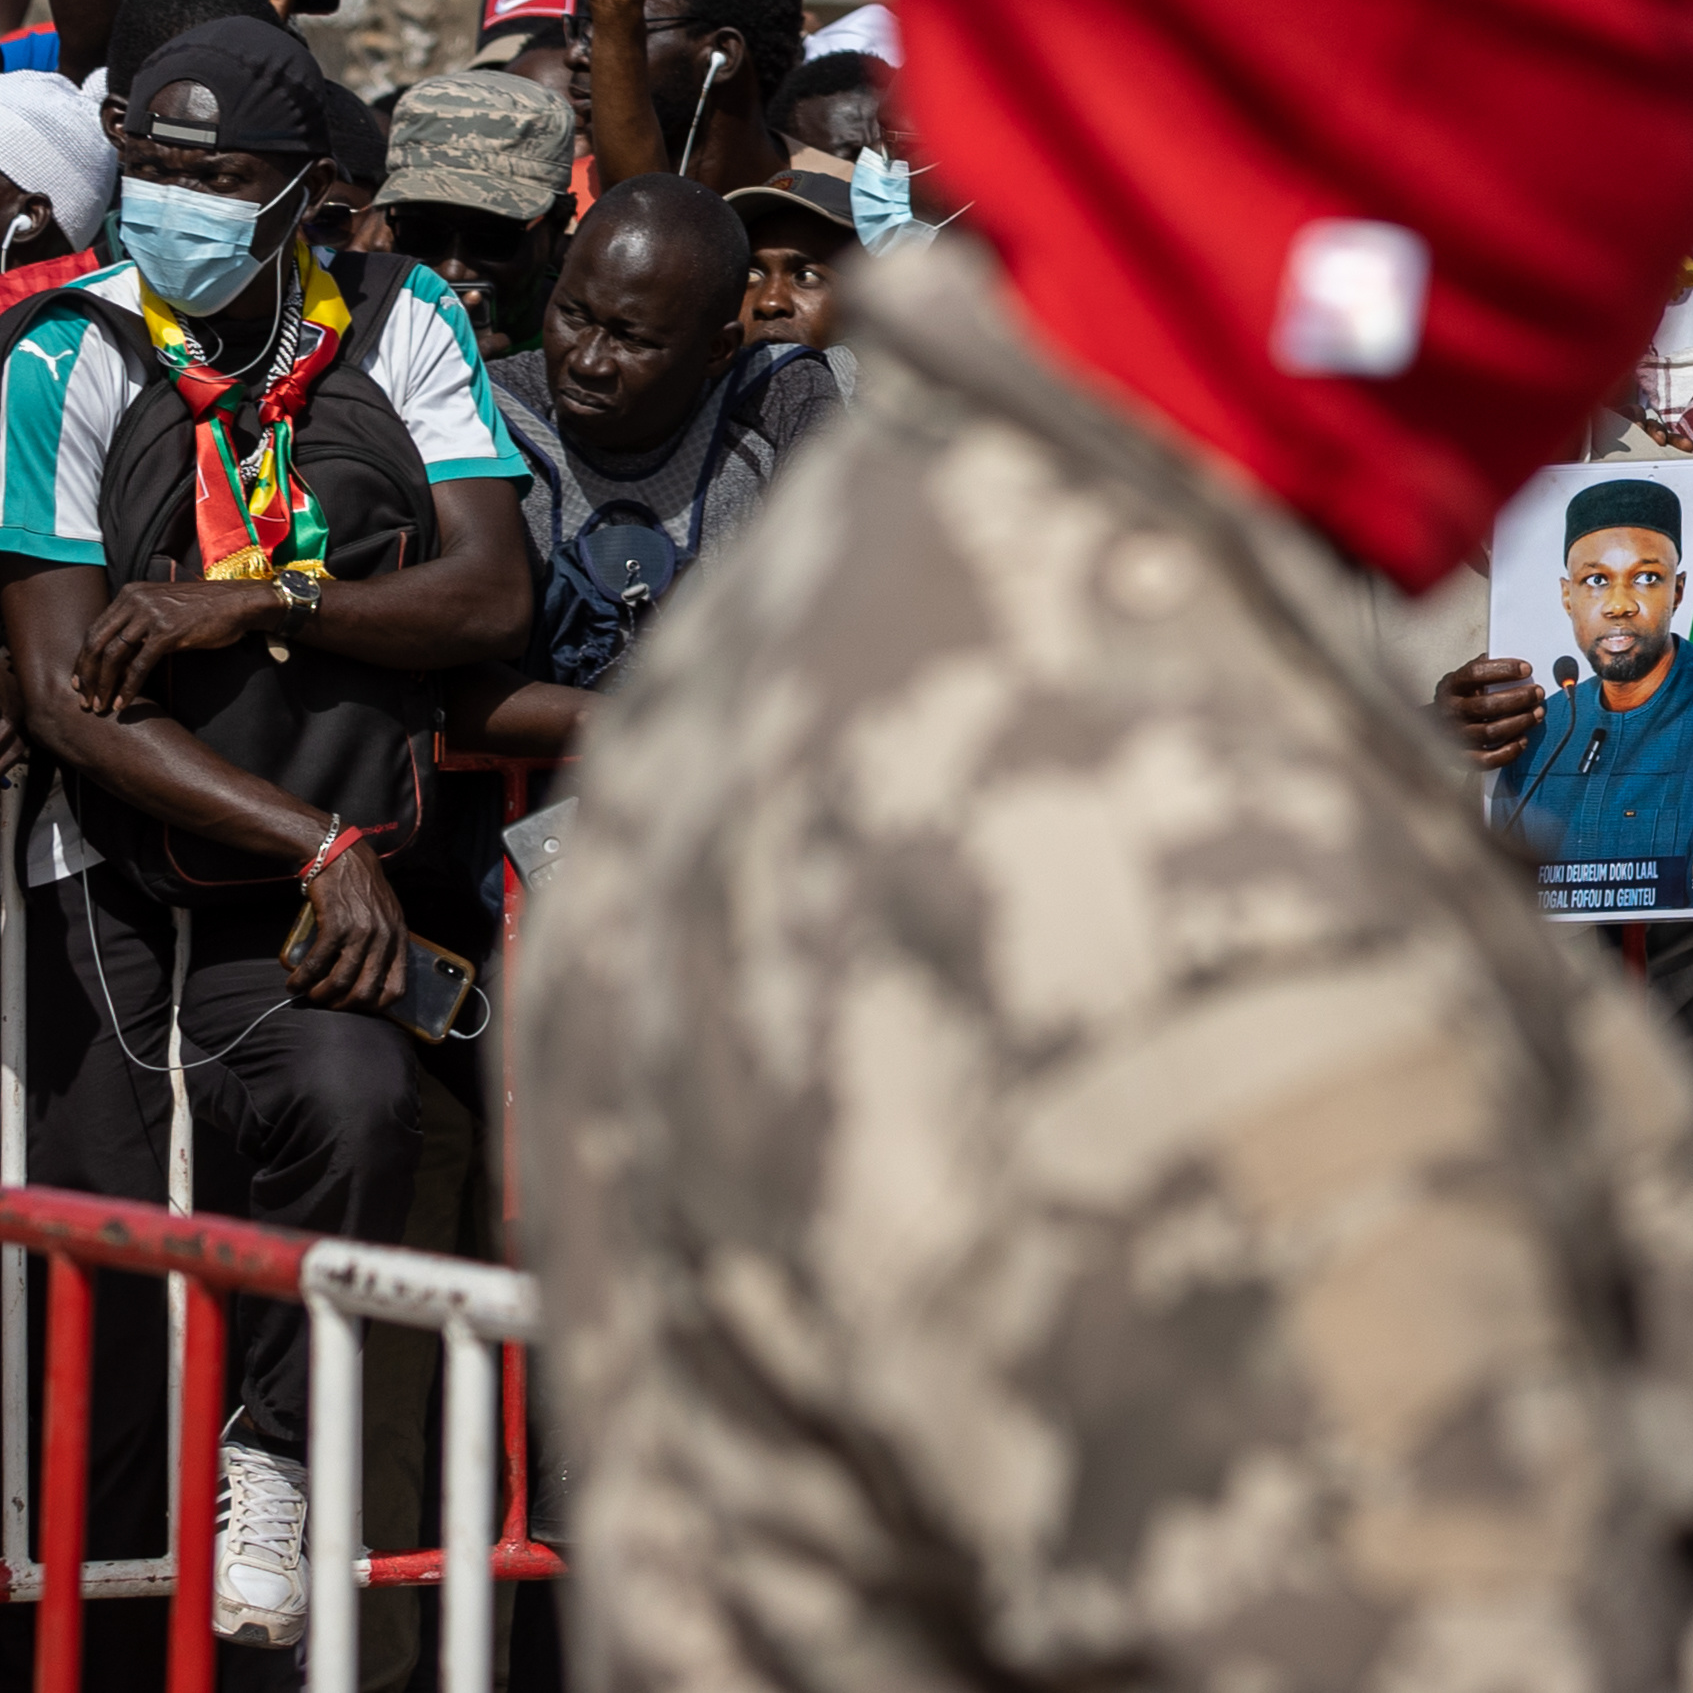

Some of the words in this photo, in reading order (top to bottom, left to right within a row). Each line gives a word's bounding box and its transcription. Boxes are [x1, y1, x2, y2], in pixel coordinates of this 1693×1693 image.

[1538, 865, 1565, 883] FOUKI
[1566, 864, 1608, 882] DEUREUM
[1609, 862, 1634, 881] DOKO
[1636, 861, 1659, 880] LAAL
[1538, 890, 1568, 909] TOGAL
[1571, 889, 1603, 908] FOFOU
[1604, 889, 1615, 907] DI
[1617, 888, 1656, 907] GEINTEU
